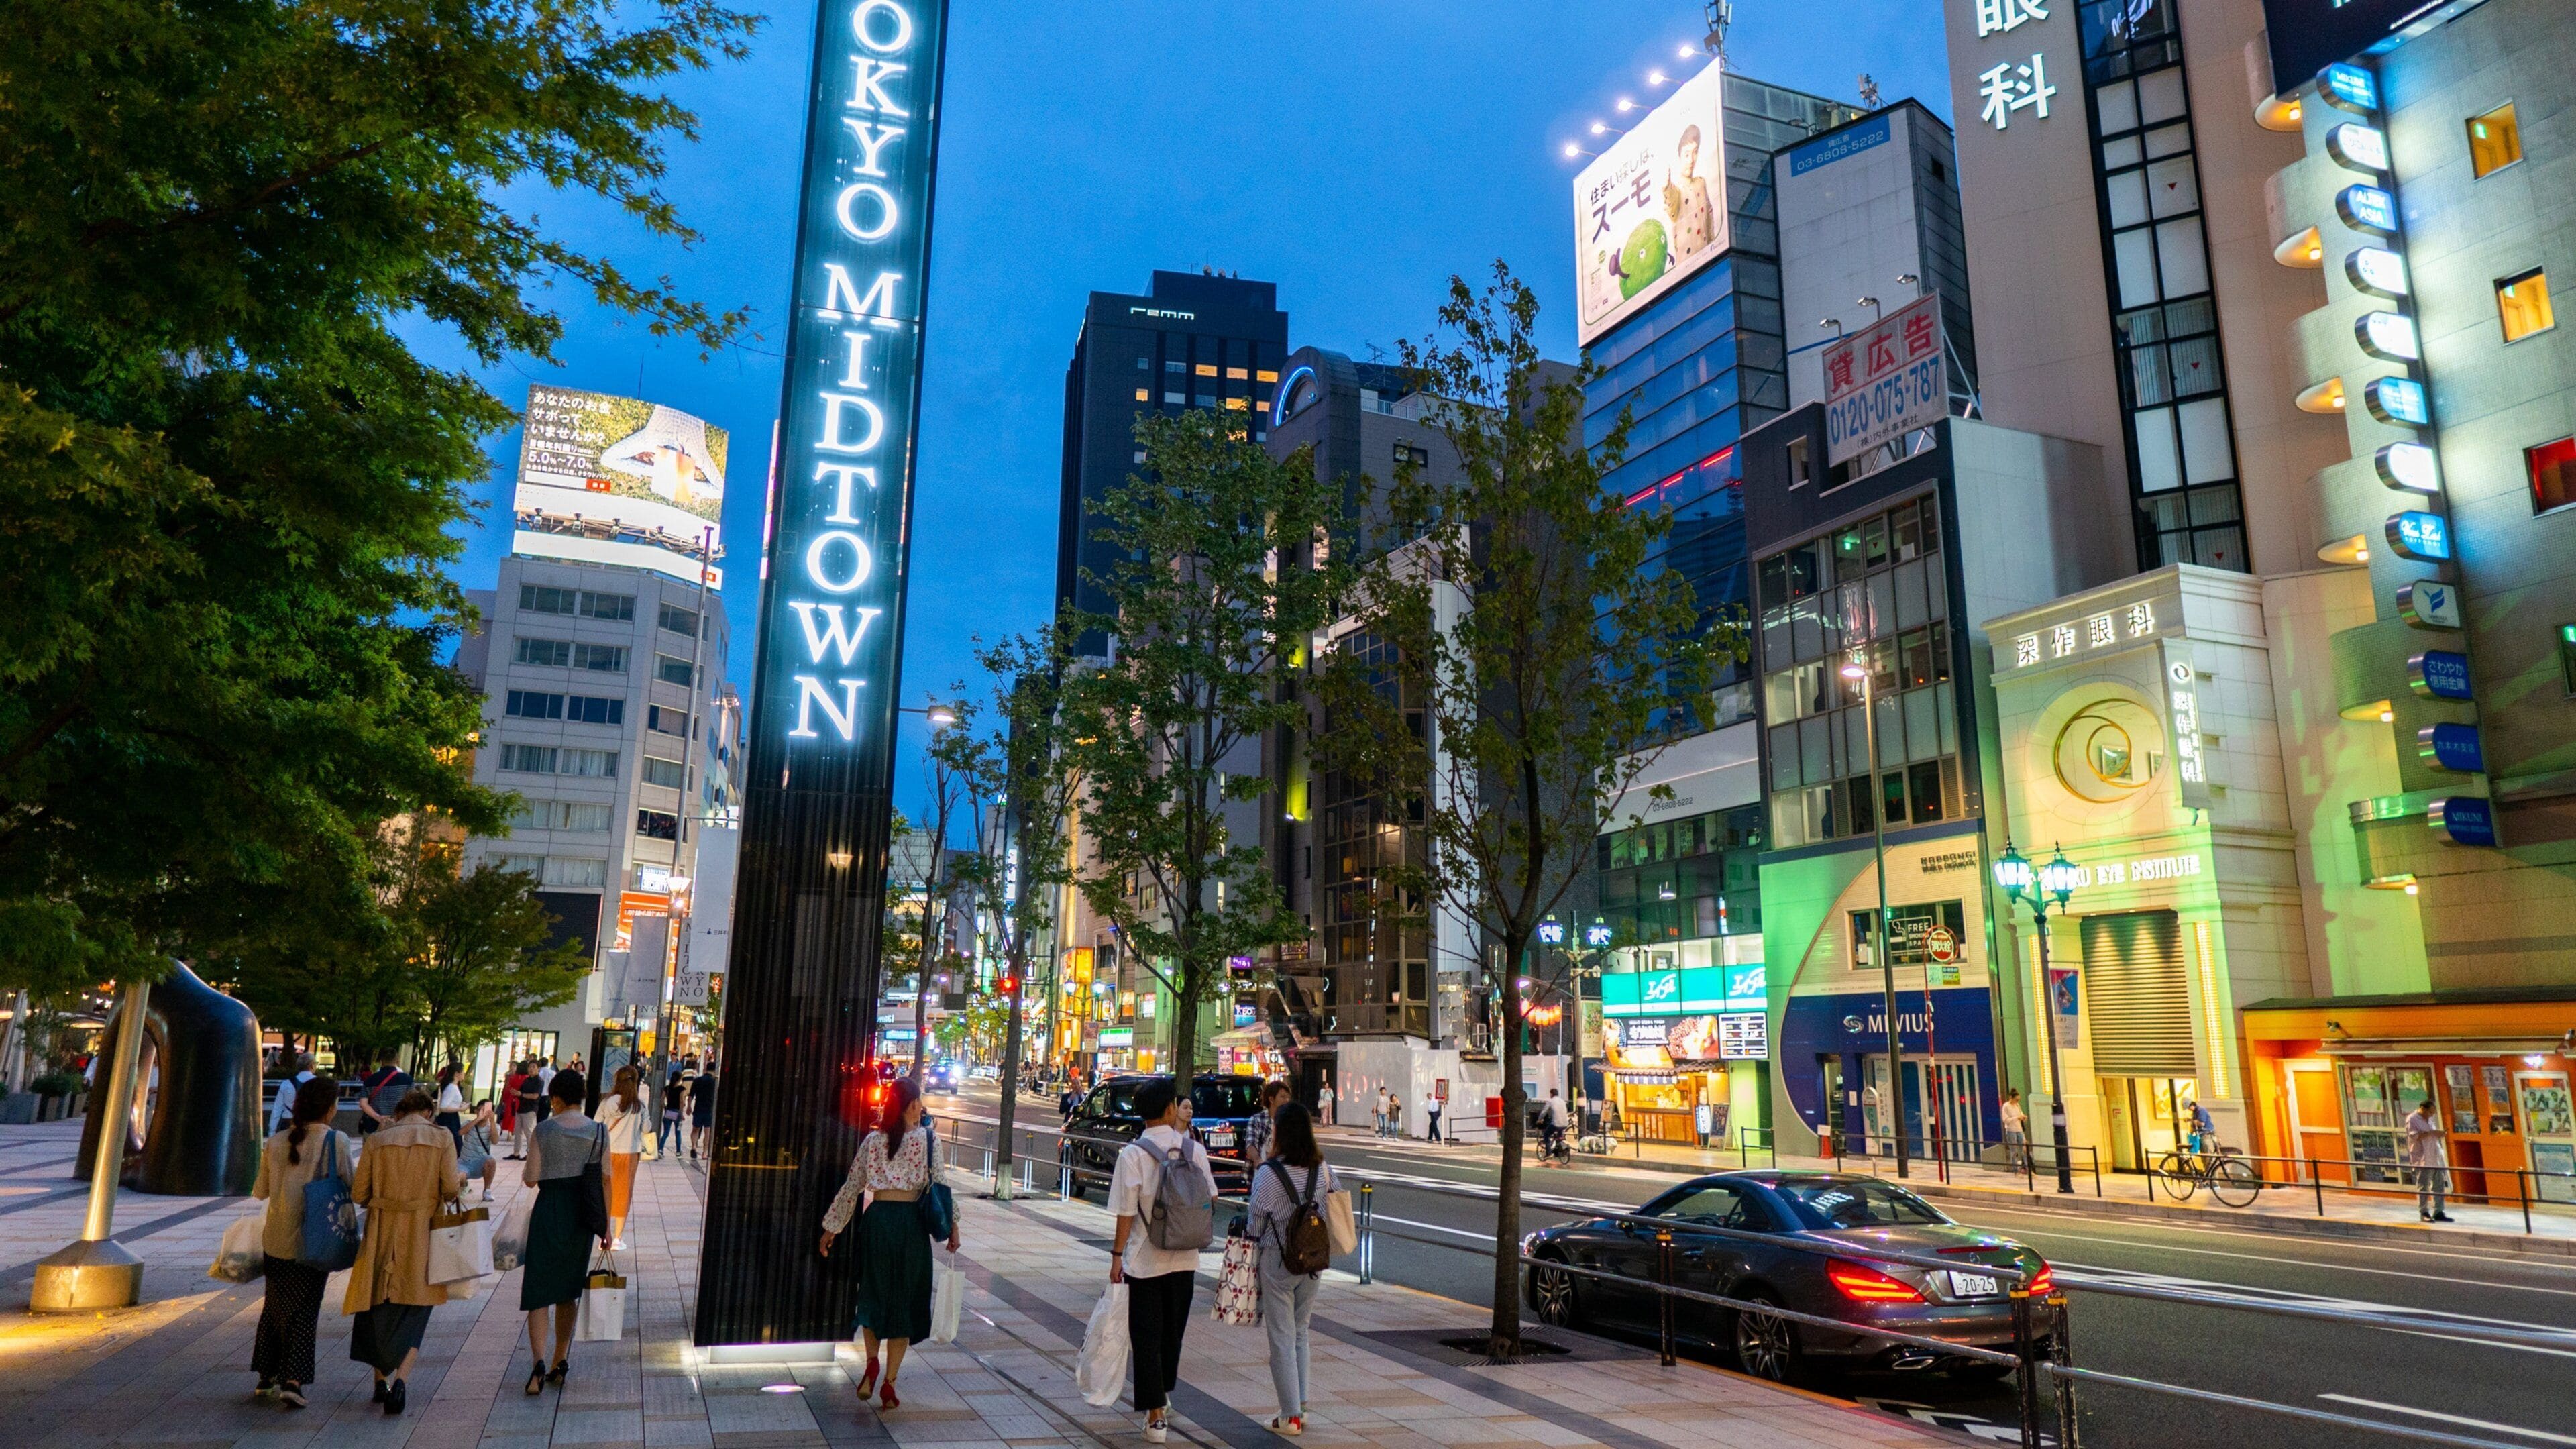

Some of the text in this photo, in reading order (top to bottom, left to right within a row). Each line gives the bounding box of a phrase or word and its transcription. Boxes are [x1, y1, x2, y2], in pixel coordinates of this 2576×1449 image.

[1796, 130, 1884, 171] 03-6808-5222
[1593, 169, 1651, 244] スーモ
[1130, 307, 1194, 320] remm
[1827, 311, 1934, 394] 貸広告
[534, 391, 610, 413] あなたのお金
[1830, 357, 1940, 445] 0120-075-787
[788, 262, 903, 740] MIDTOWN
[2015, 603, 2155, 667] 深作眼科
[2428, 661, 2465, 676] さわやか
[2430, 675, 2466, 690] 信用金庫
[2095, 863, 2126, 885] EYE
[2130, 854, 2201, 882] INSTITUTE
[1907, 922, 1929, 932] FREE
[1931, 940, 1951, 952] 消火栓
[1963, 1278, 1994, 1293] 20-25
